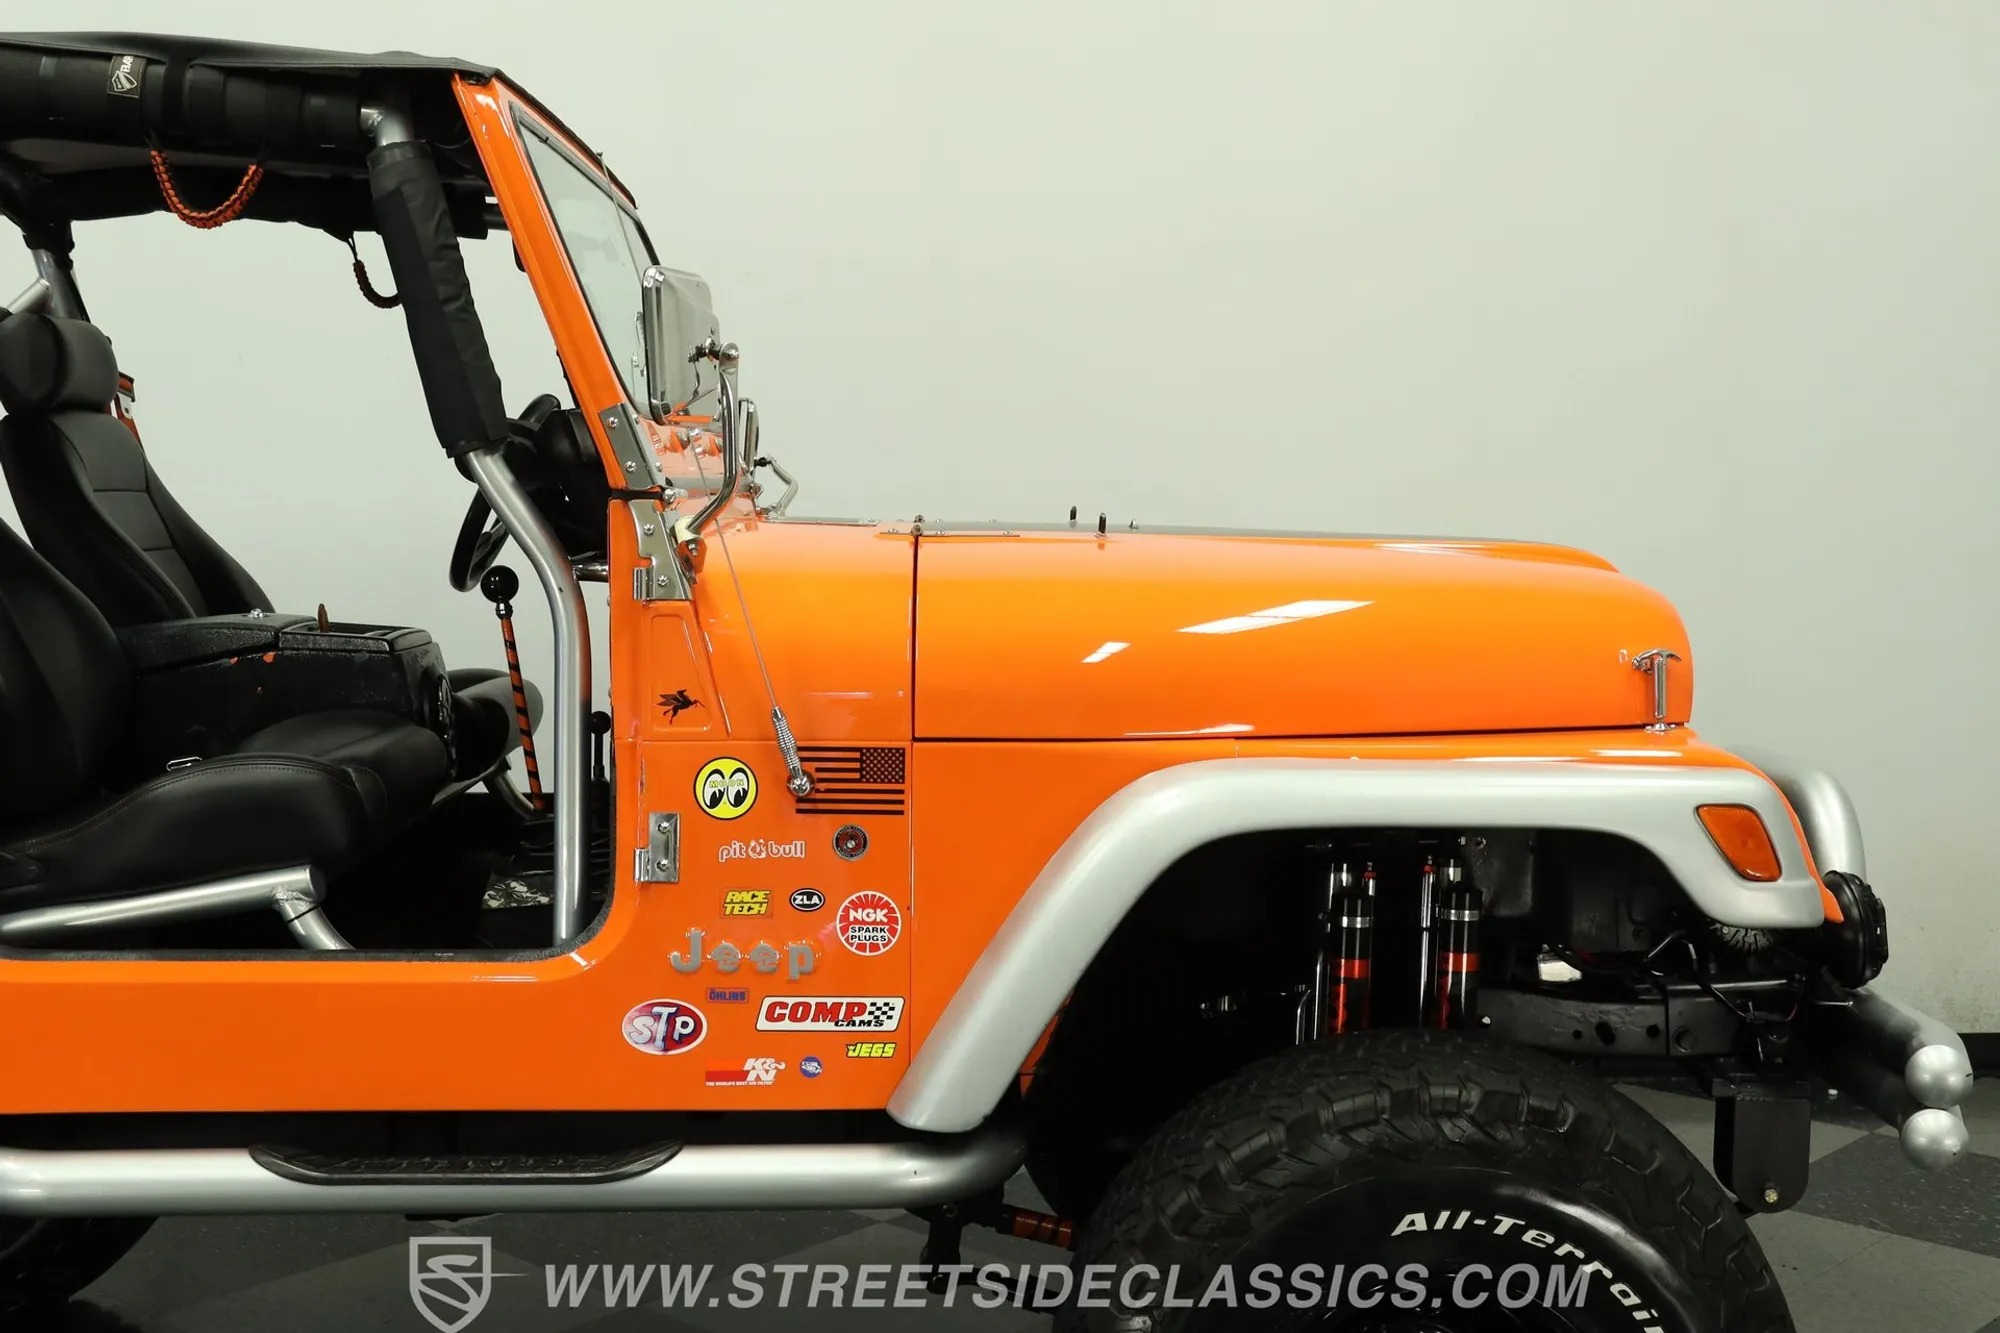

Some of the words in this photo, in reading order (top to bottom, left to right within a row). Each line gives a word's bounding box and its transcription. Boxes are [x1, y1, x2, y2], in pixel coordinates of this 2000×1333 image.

[708, 778, 745, 788] MOON
[718, 840, 747, 863] pit
[767, 840, 806, 859] bull
[725, 890, 771, 903] RACE
[794, 894, 820, 905] ZLA
[723, 903, 767, 916] TECH
[849, 907, 889, 923] NGK
[849, 926, 887, 934] SPARK
[849, 934, 887, 943] PLUGS
[669, 929, 815, 981] Jeep
[764, 1001, 868, 1023] COMP
[628, 1006, 696, 1049] STP
[833, 1019, 885, 1028] CAMS
[847, 1042, 897, 1058] JEGS
